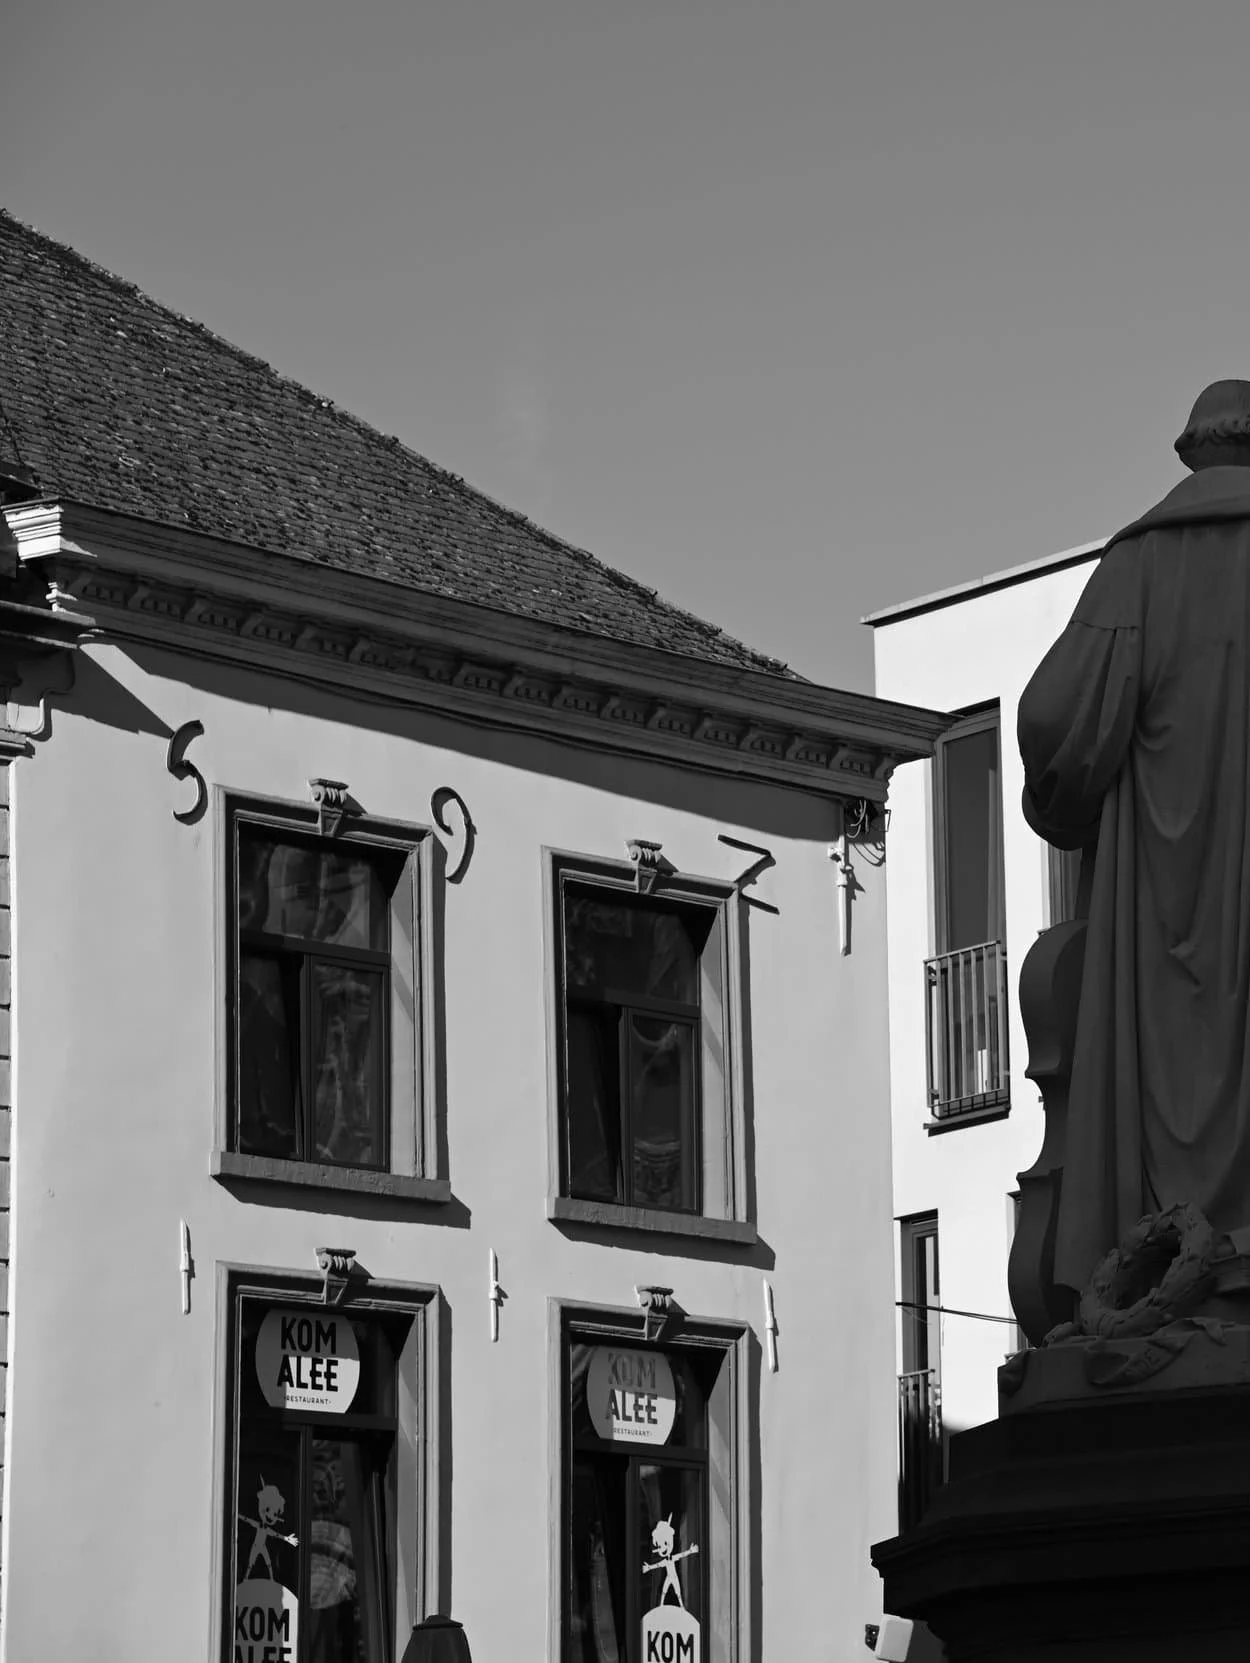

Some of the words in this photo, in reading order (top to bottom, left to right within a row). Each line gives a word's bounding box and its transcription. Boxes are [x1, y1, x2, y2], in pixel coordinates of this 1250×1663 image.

[281, 1316, 336, 1355] KOM
[277, 1354, 338, 1392] ALEE
[608, 1352, 656, 1389] KOM
[606, 1389, 658, 1424] ALEE
[235, 1606, 290, 1642] KOM
[647, 1630, 694, 1663] KOM
